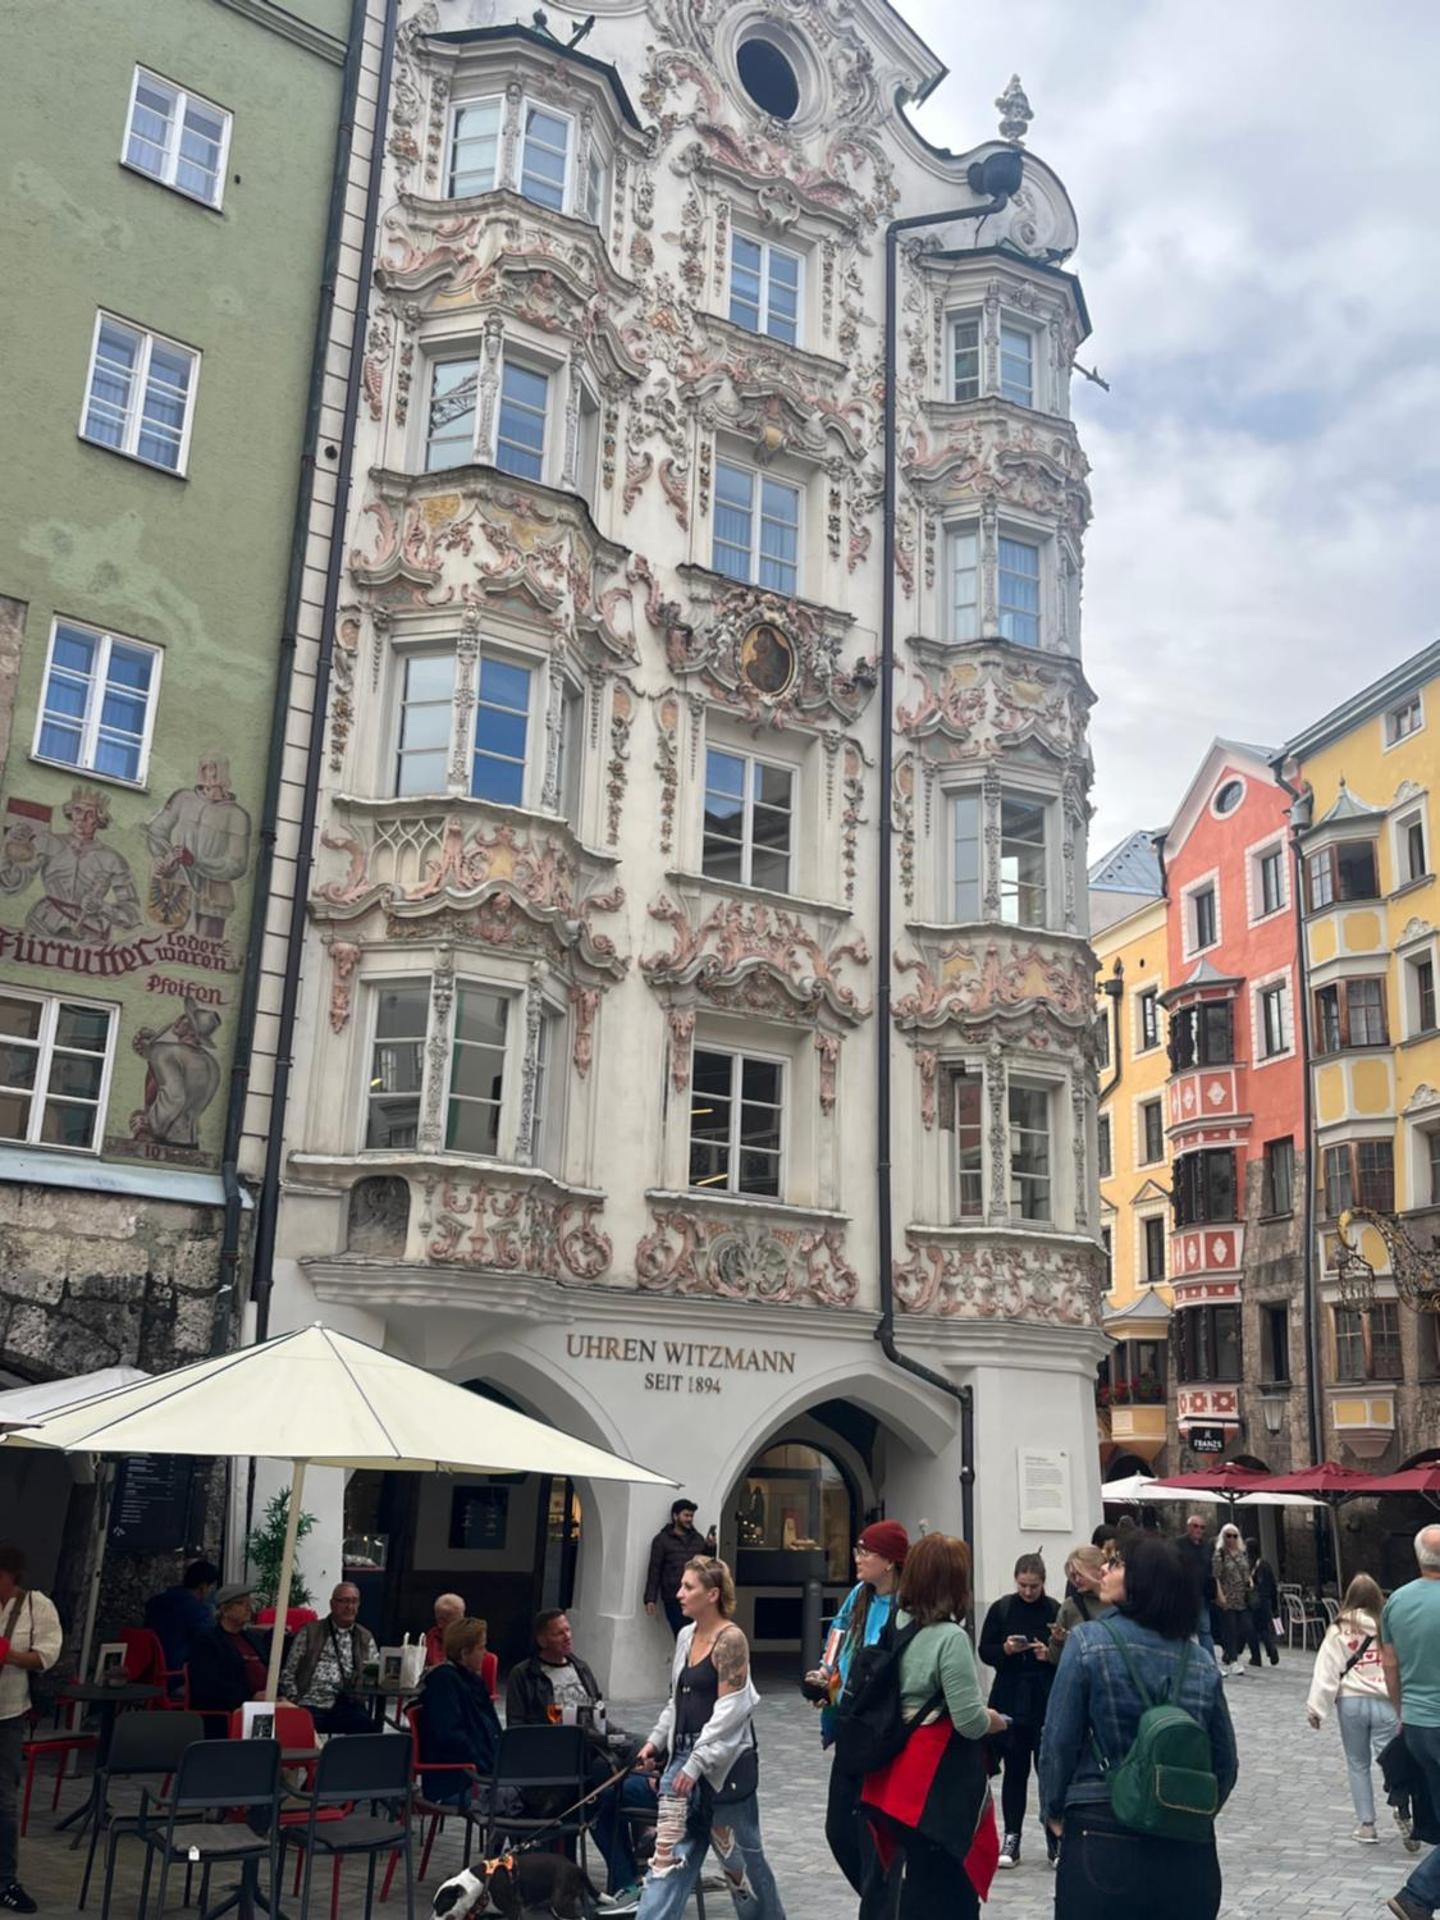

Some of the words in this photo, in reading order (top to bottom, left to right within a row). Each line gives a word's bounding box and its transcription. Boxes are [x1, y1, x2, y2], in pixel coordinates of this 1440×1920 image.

[566, 1333, 657, 1363] UHREN
[663, 1341, 796, 1374] WITZMANN
[644, 1373, 683, 1392] SEIT
[688, 1376, 721, 1394] 1894
